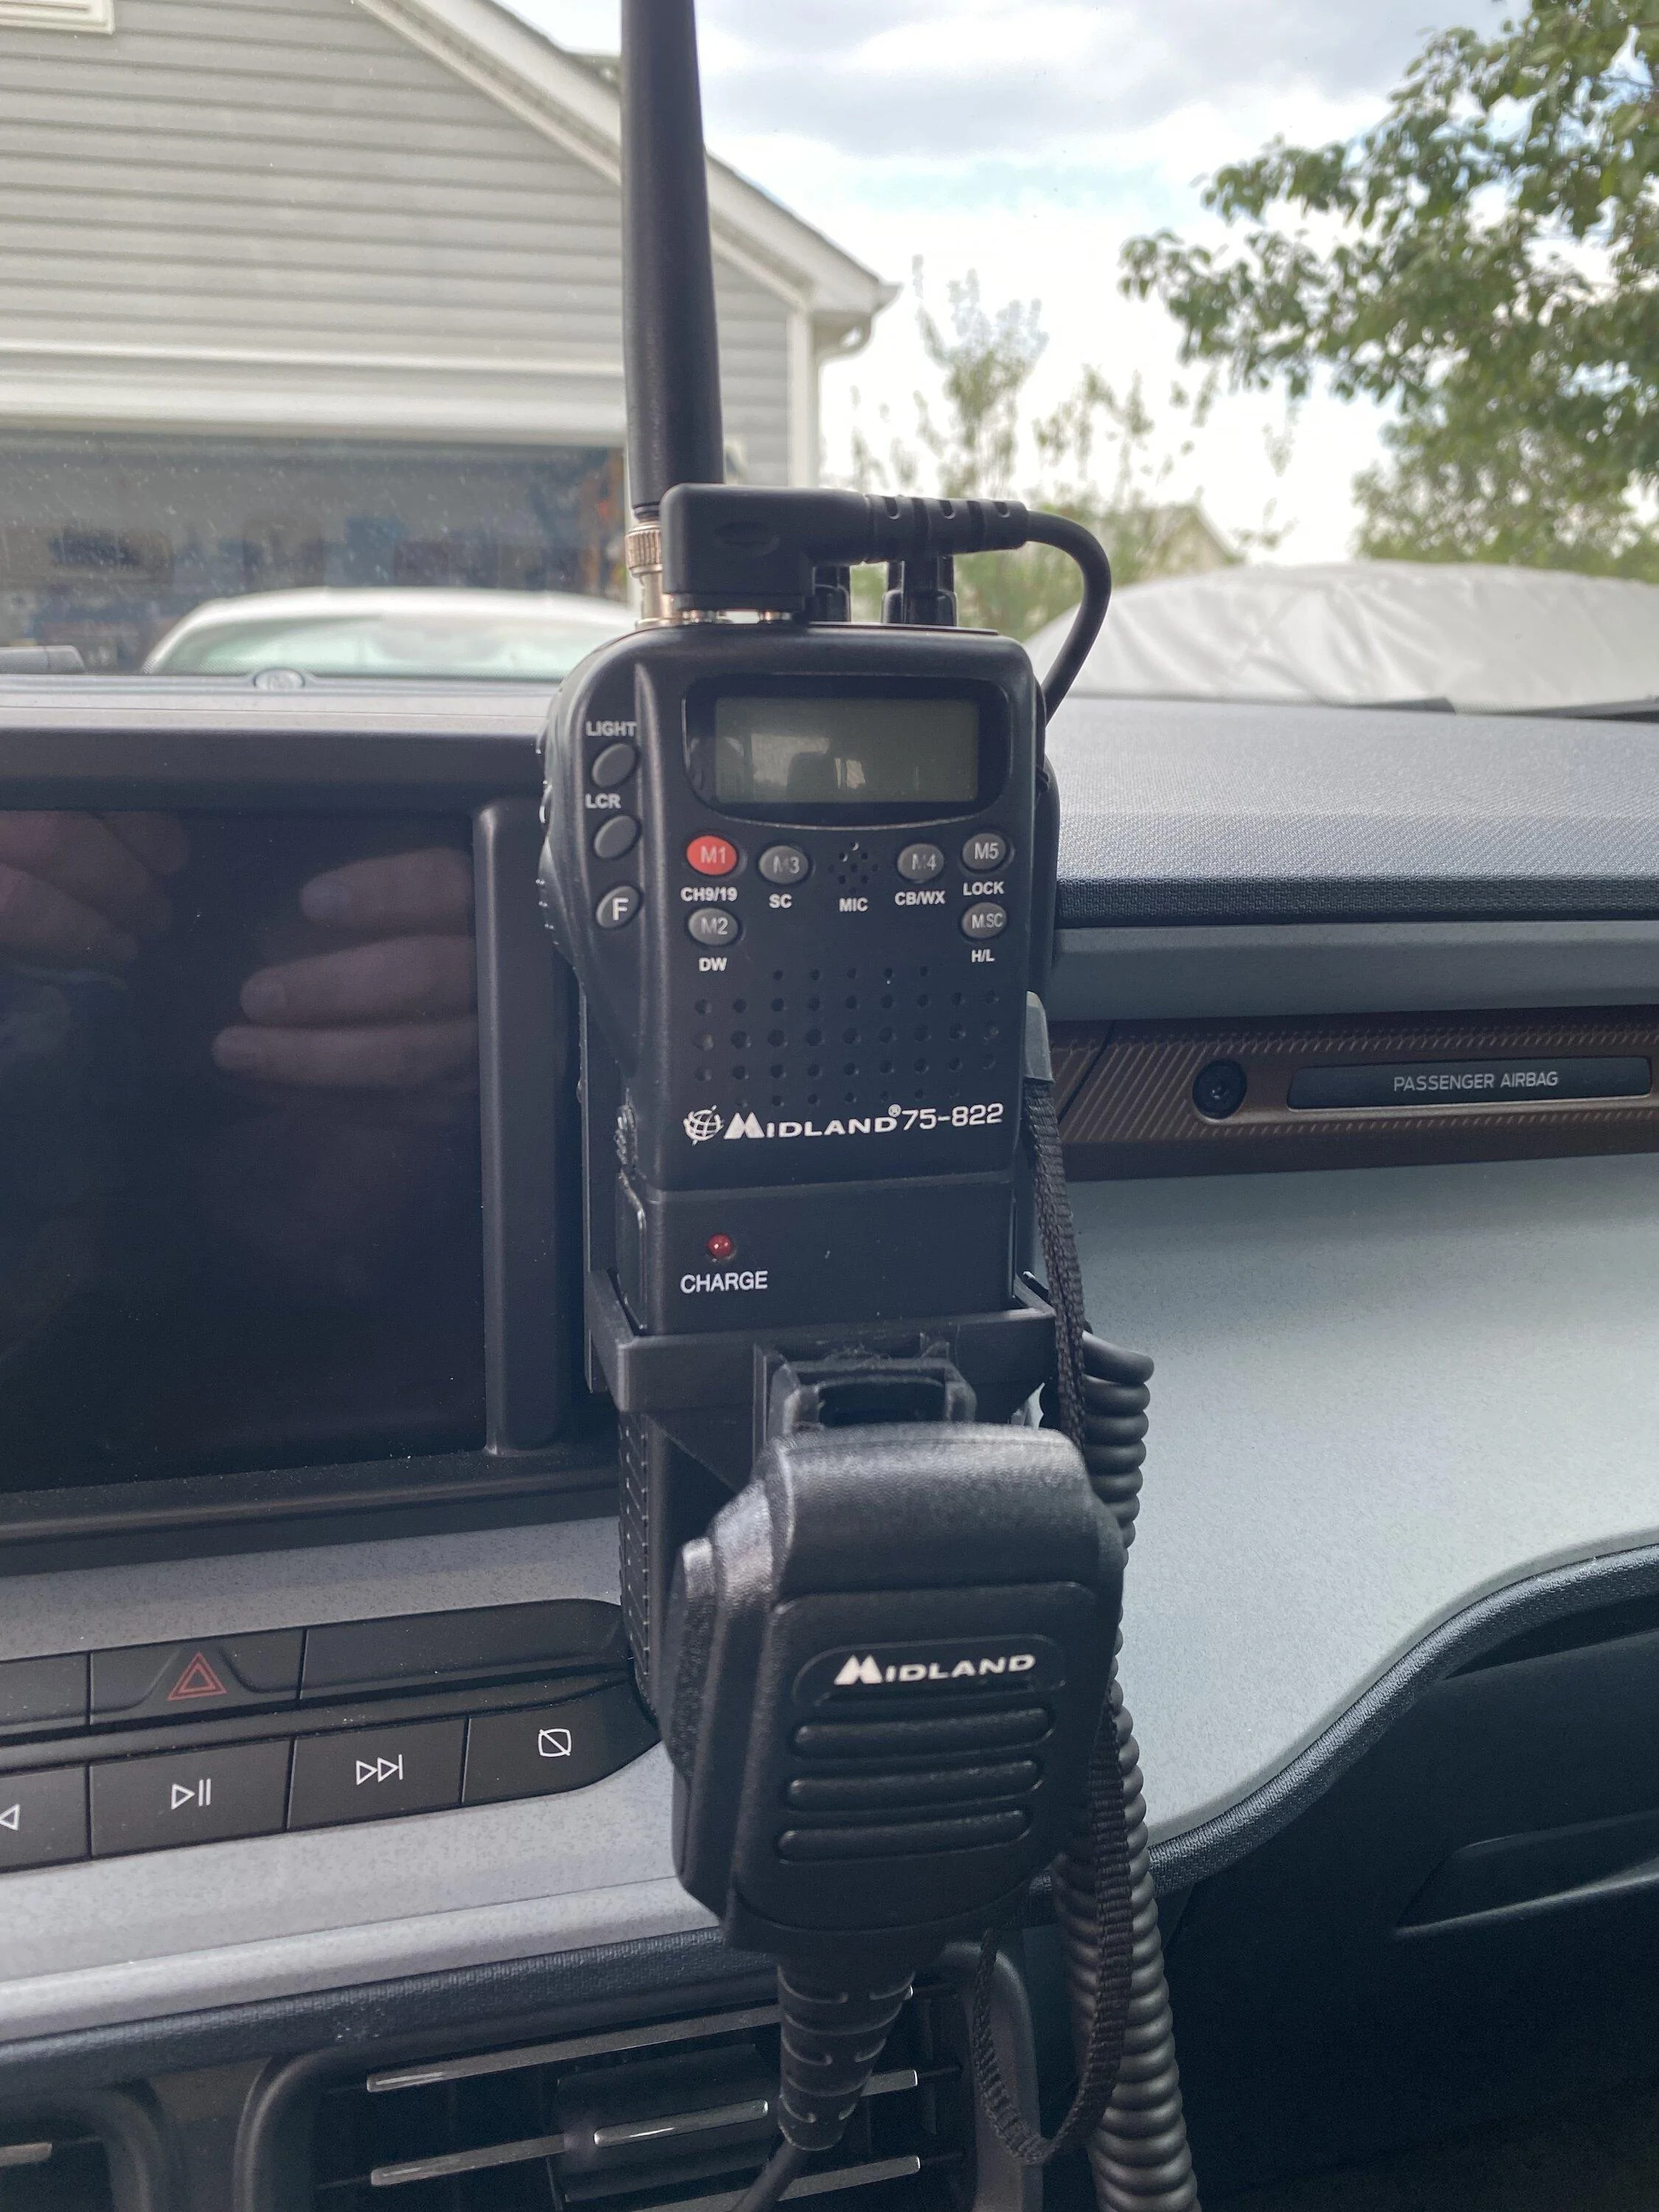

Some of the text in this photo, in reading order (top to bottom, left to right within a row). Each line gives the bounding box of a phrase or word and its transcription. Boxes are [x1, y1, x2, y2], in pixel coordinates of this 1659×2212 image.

[585, 720, 637, 737] LIGHT
[585, 793, 622, 809] LCR
[700, 846, 726, 864] M1
[974, 842, 999, 860] M5
[681, 887, 737, 902] CH9/19
[963, 881, 1004, 896] LOCK
[768, 894, 793, 908] SC
[839, 898, 868, 912] MIC
[894, 891, 945, 906] CB/WX
[612, 897, 629, 921] F
[701, 917, 728, 935] M2
[971, 948, 995, 962] H/L
[698, 958, 728, 972] DW
[1394, 1071, 1559, 1091] PASSENGER AIRBAG
[901, 1102, 1004, 1131] 75-822
[680, 1270, 768, 1294] CHARGE
[834, 1654, 1036, 1686] MIDLAND
